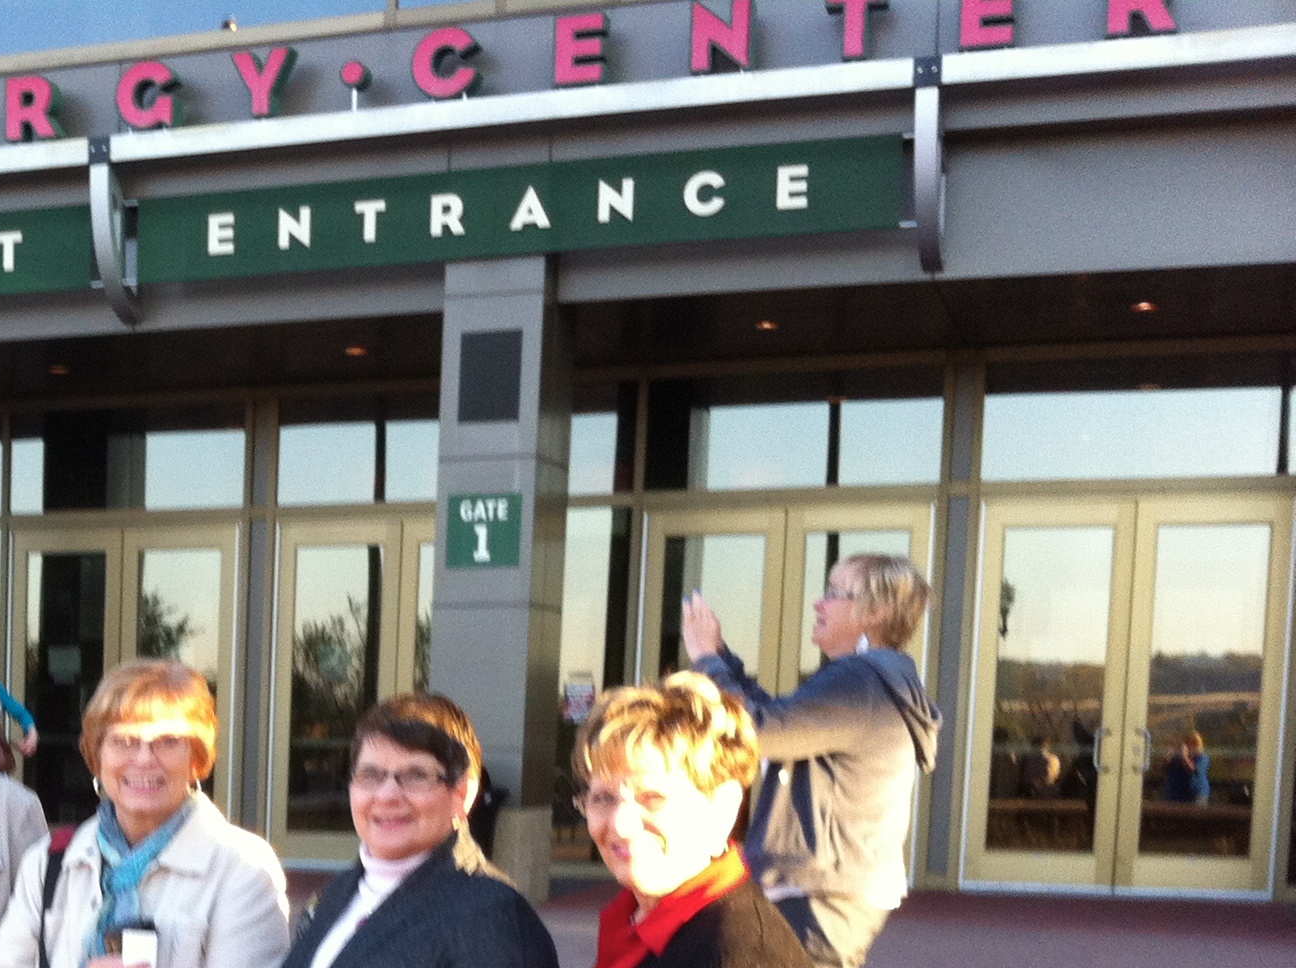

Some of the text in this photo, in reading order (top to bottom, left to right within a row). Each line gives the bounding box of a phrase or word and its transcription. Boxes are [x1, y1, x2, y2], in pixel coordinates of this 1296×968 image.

[206, 163, 810, 256] ENTRANCE
[460, 498, 508, 522] GATE
[473, 524, 491, 563] 1
